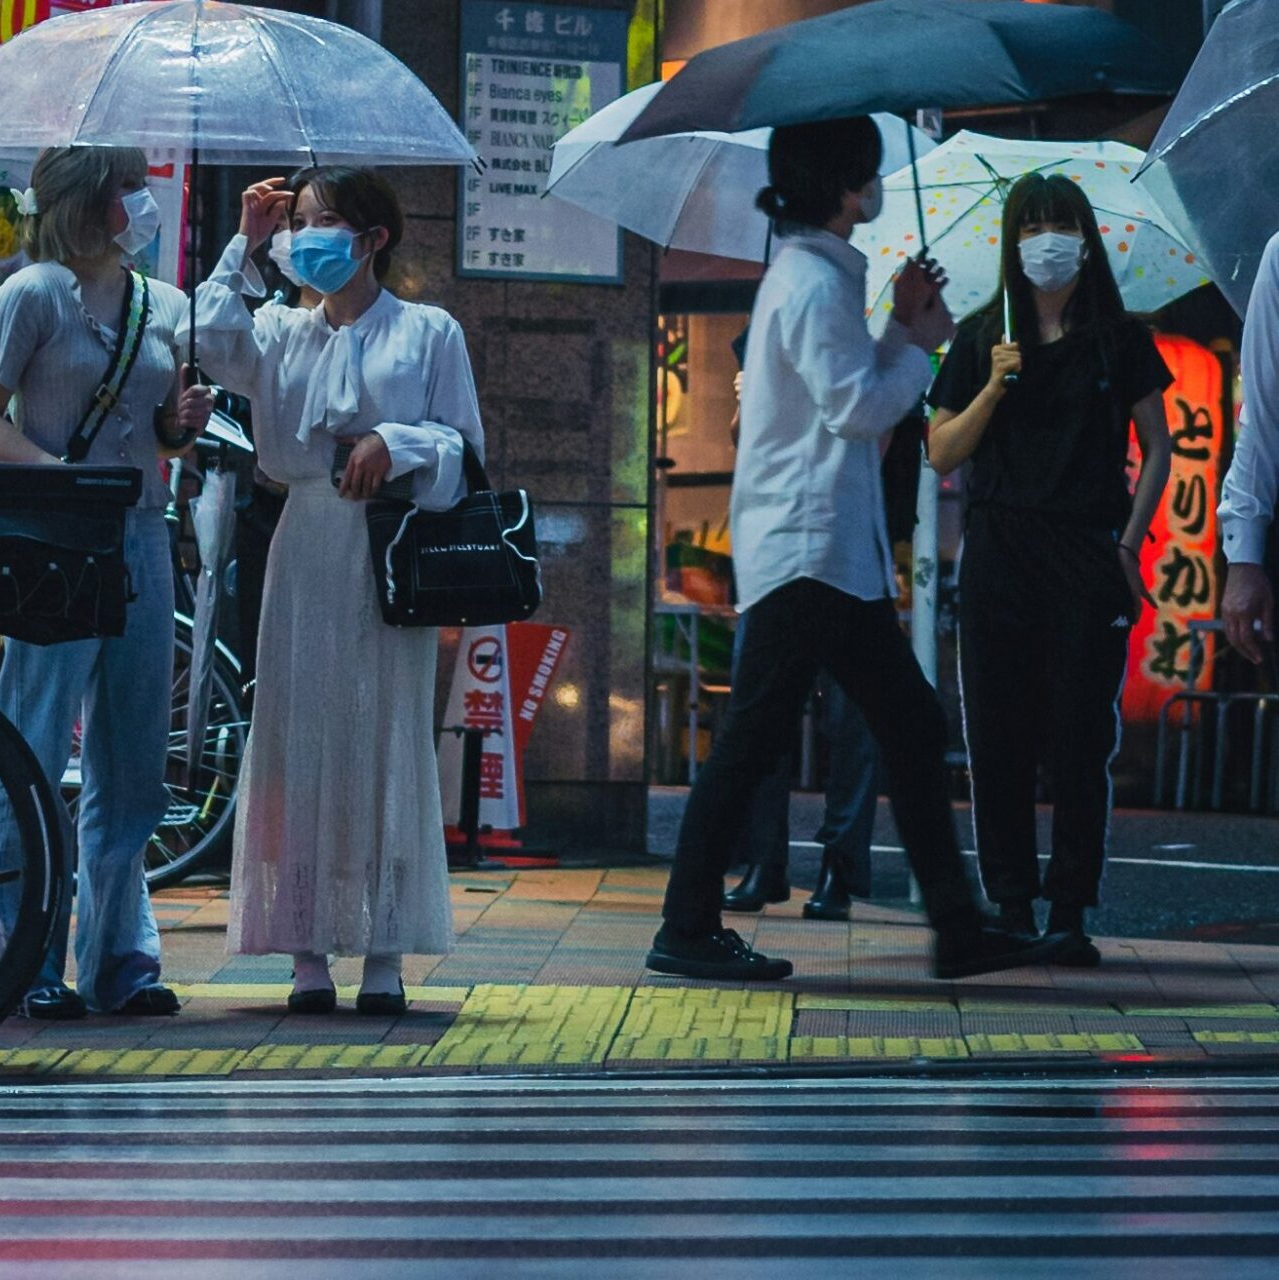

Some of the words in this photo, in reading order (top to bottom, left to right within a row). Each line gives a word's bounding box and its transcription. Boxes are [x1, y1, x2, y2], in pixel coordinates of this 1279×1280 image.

[489, 83, 531, 100] Bianca
[534, 90, 562, 104] eyes
[514, 183, 537, 195] MAX
[488, 227, 525, 243] すき家
[488, 252, 524, 267] すき家
[1149, 396, 1214, 681] とりかわ
[519, 695, 539, 721] NO
[529, 629, 568, 698] SMOKING
